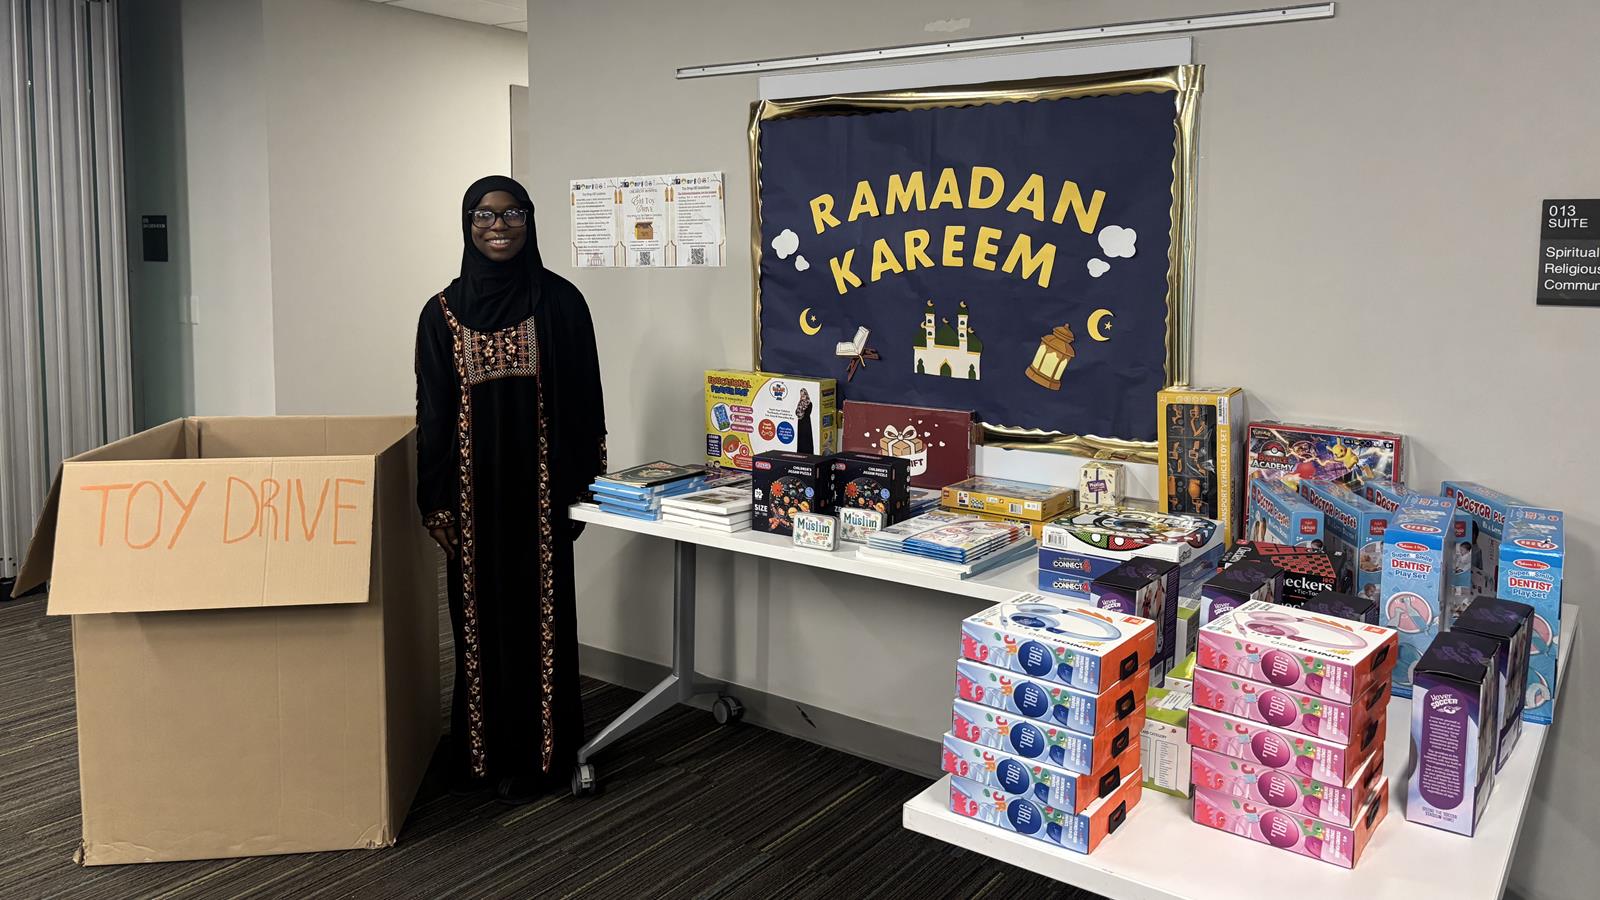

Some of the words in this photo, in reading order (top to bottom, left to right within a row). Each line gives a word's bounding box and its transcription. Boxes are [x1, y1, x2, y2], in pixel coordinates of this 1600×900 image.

[809, 166, 1106, 235] RAMADAN
[1549, 205, 1576, 217] 013
[1548, 218, 1589, 228] SUITE
[829, 225, 1057, 295] KAREEM
[1546, 246, 1600, 260] Spiritual
[910, 458, 924, 467] IFT
[1251, 459, 1294, 471] ACADEMY
[755, 503, 768, 512] SIZE
[1375, 489, 1400, 512] DOCT
[1456, 489, 1492, 520] DOCTOR
[80, 479, 207, 550] TOY
[223, 476, 366, 545] DRIVE
[844, 512, 877, 528] Muslim
[798, 517, 830, 533] Muslim
[1053, 561, 1083, 569] CONNECT
[1391, 558, 1432, 573] DENTIST
[1395, 569, 1412, 578] Play
[1053, 581, 1082, 590] CONNECT
[1283, 577, 1332, 591] eckers
[1509, 577, 1552, 591] DENTIST
[1513, 588, 1530, 598] Play
[1531, 591, 1546, 599] Set
[1053, 638, 1099, 652] JUNIOR
[1027, 646, 1043, 667] JBL
[1299, 647, 1350, 661] JUNIOR
[1271, 656, 1288, 676] JBL
[1023, 687, 1039, 708] JBL
[1431, 699, 1458, 709] SOCCER
[1269, 696, 1286, 717] JBL
[1019, 727, 1036, 748] JBL
[1263, 736, 1280, 758] JBL
[1005, 764, 1021, 786] JBL
[1269, 776, 1286, 798] JBL
[1016, 803, 1033, 825] JBL
[1271, 816, 1288, 838] JBL
